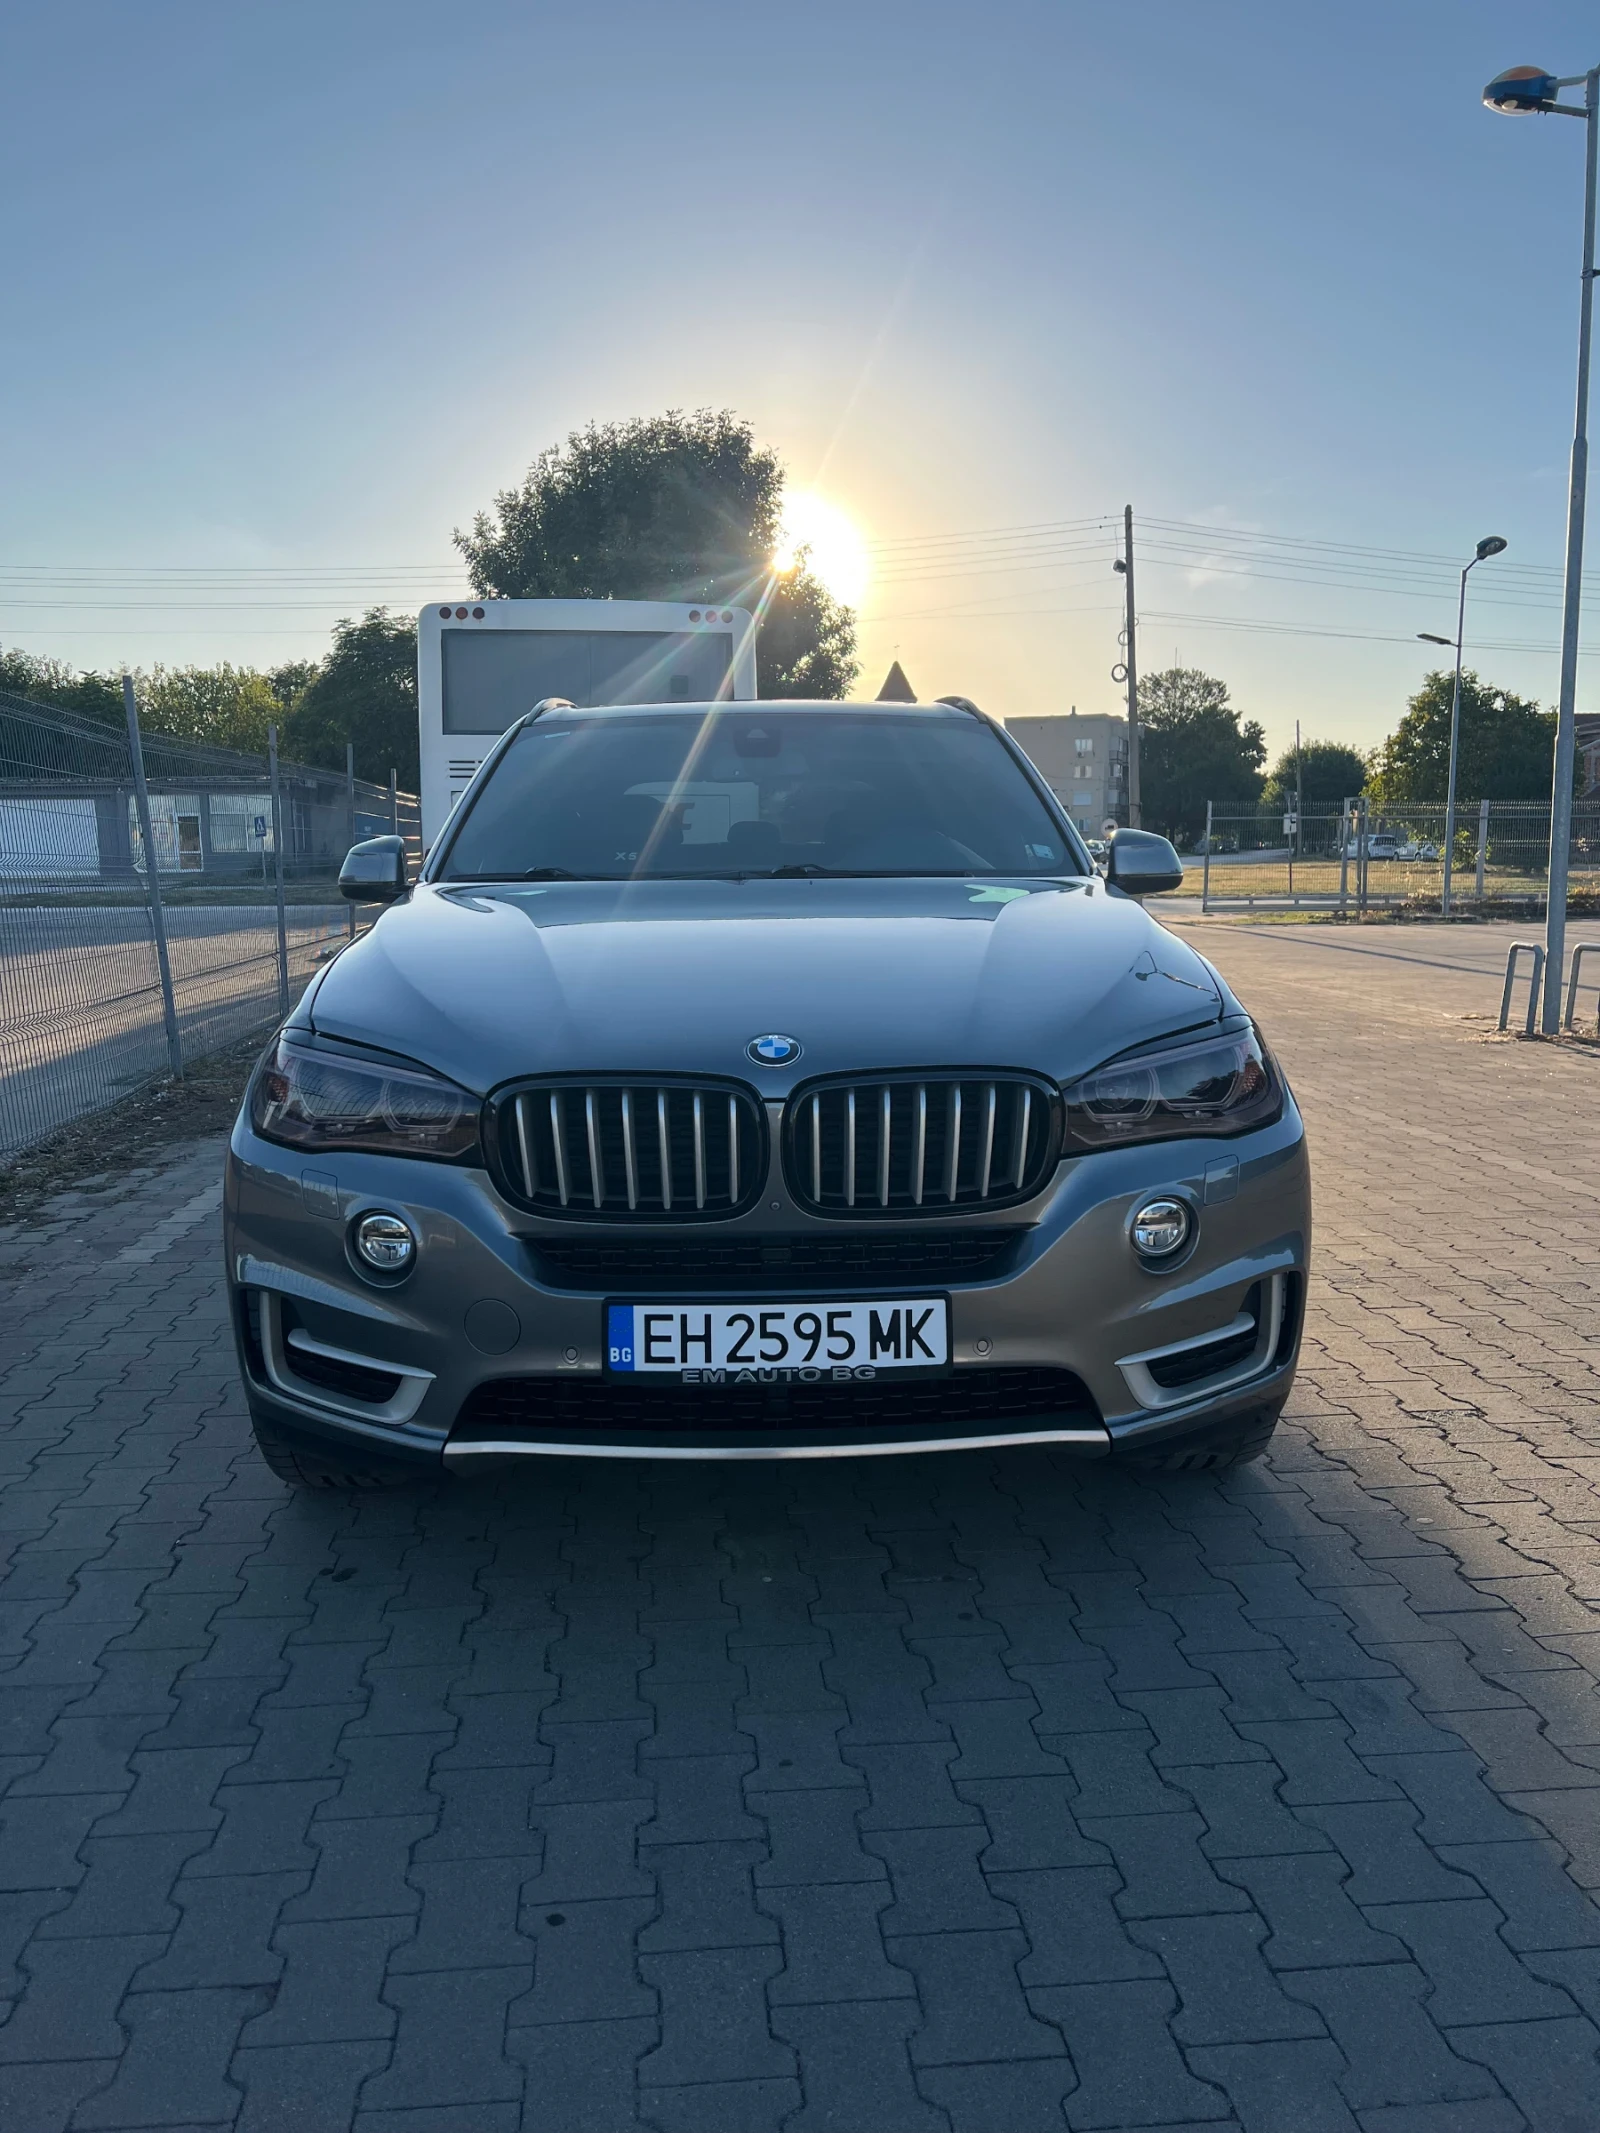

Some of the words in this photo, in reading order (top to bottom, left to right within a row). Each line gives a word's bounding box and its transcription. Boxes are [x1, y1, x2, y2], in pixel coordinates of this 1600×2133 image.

[643, 1313, 713, 1364] EH
[725, 1310, 856, 1364] 2595
[868, 1307, 937, 1361] MK
[609, 1347, 632, 1363] BG
[681, 1367, 726, 1384] EM
[734, 1366, 822, 1384] AUTO
[832, 1364, 877, 1382] BG
